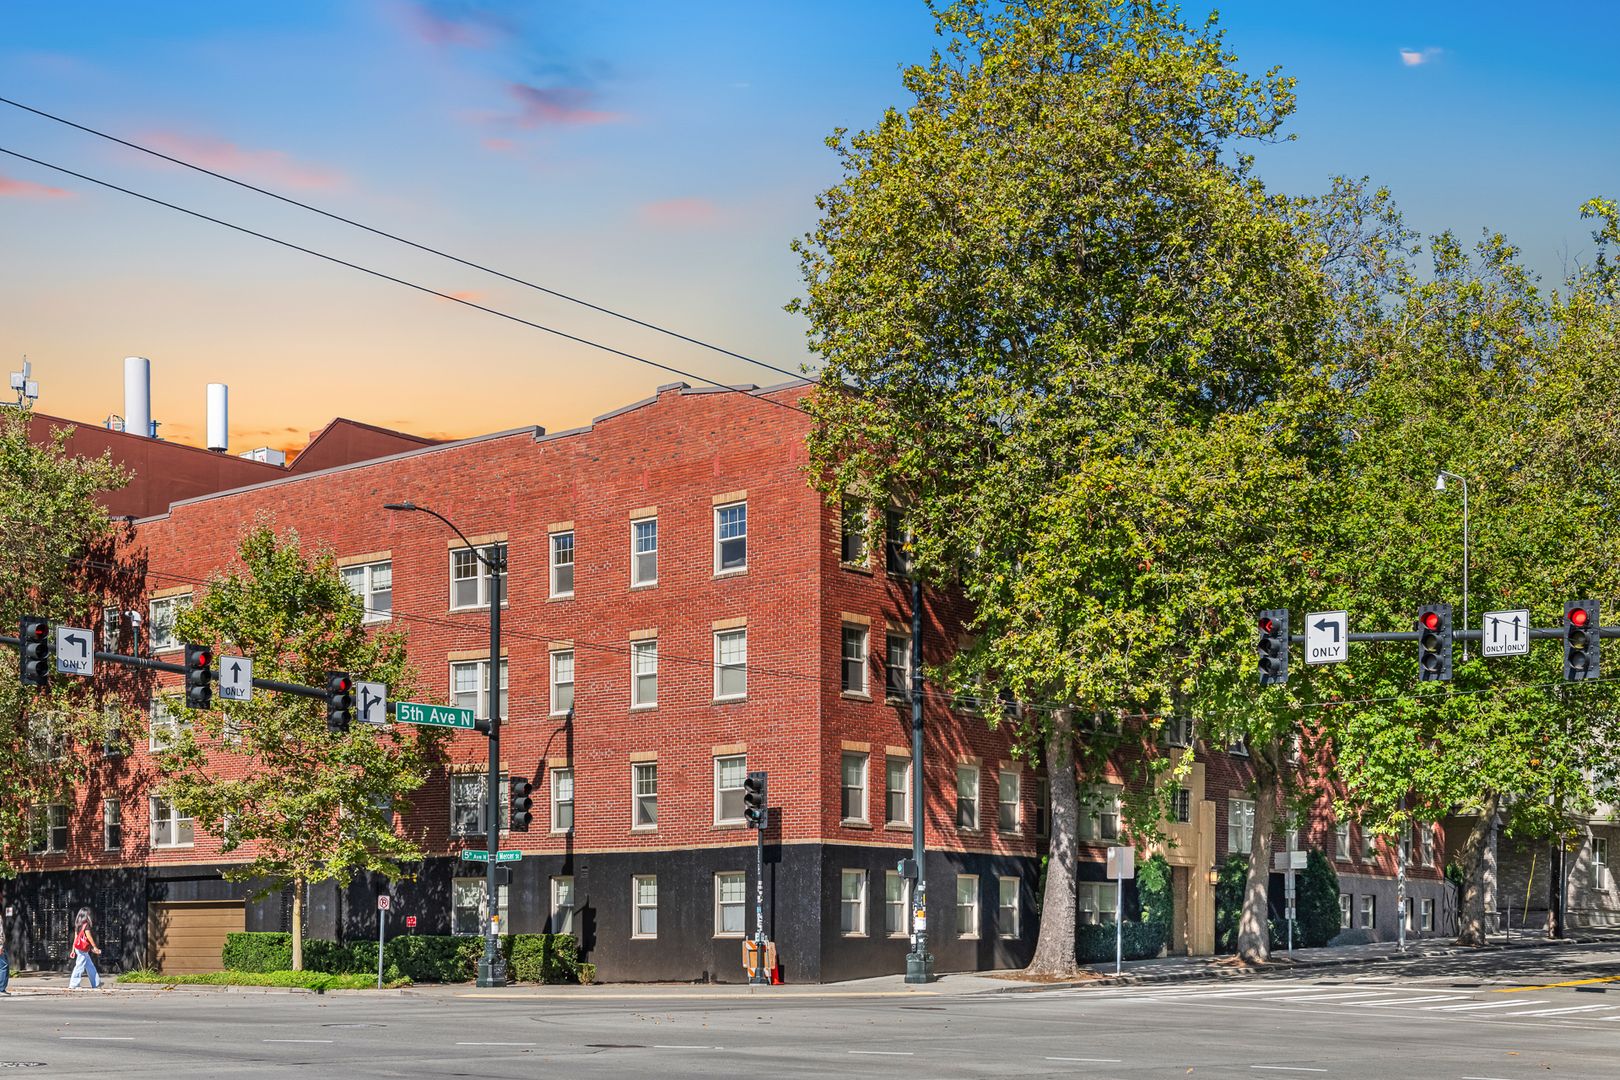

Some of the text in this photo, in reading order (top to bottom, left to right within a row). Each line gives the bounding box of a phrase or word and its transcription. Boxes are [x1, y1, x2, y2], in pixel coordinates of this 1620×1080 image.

[1312, 646, 1340, 658] ONLY
[1486, 645, 1504, 653] ONLY
[1507, 643, 1525, 651] ONLY
[62, 659, 88, 670] ONLY
[225, 686, 246, 697] ONLY
[401, 705, 470, 726] 5th Ave N
